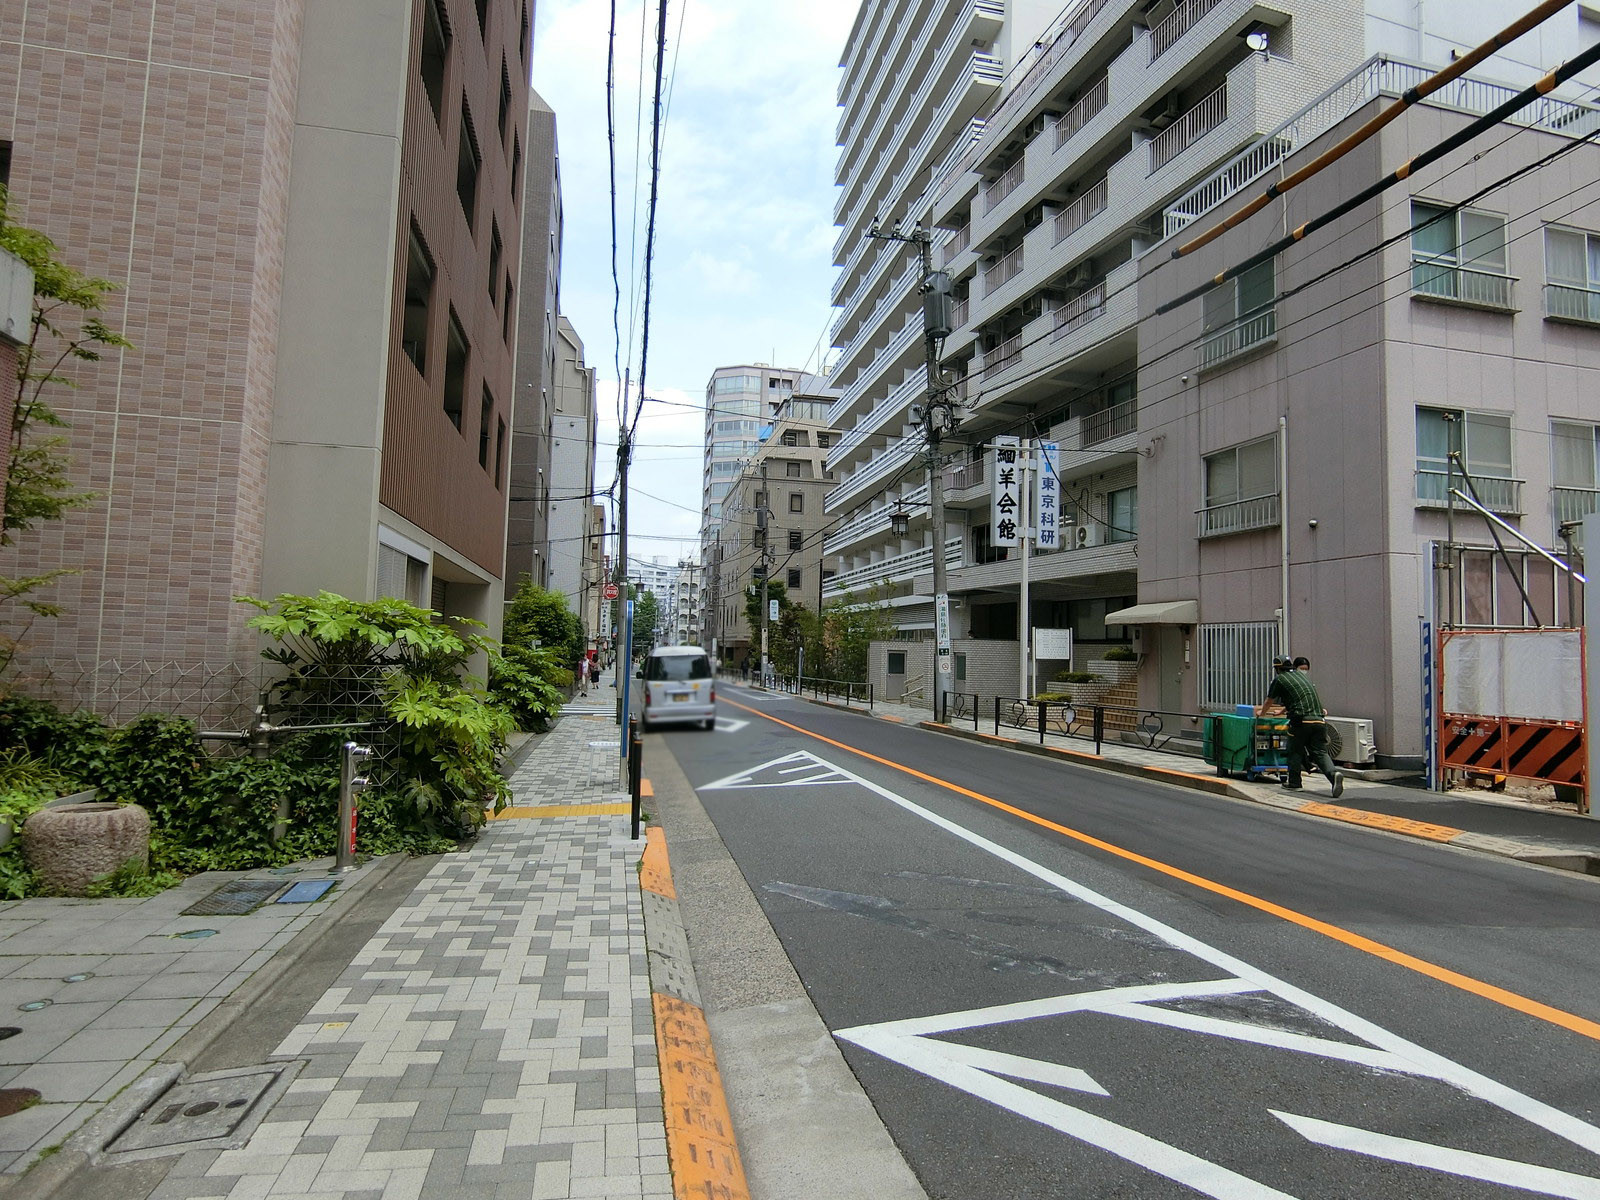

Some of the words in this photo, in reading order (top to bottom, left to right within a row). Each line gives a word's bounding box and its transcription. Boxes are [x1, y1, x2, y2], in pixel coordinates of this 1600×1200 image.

[997, 444, 1017, 540] 緬羊会館
[1041, 477, 1055, 544] 東京科研
